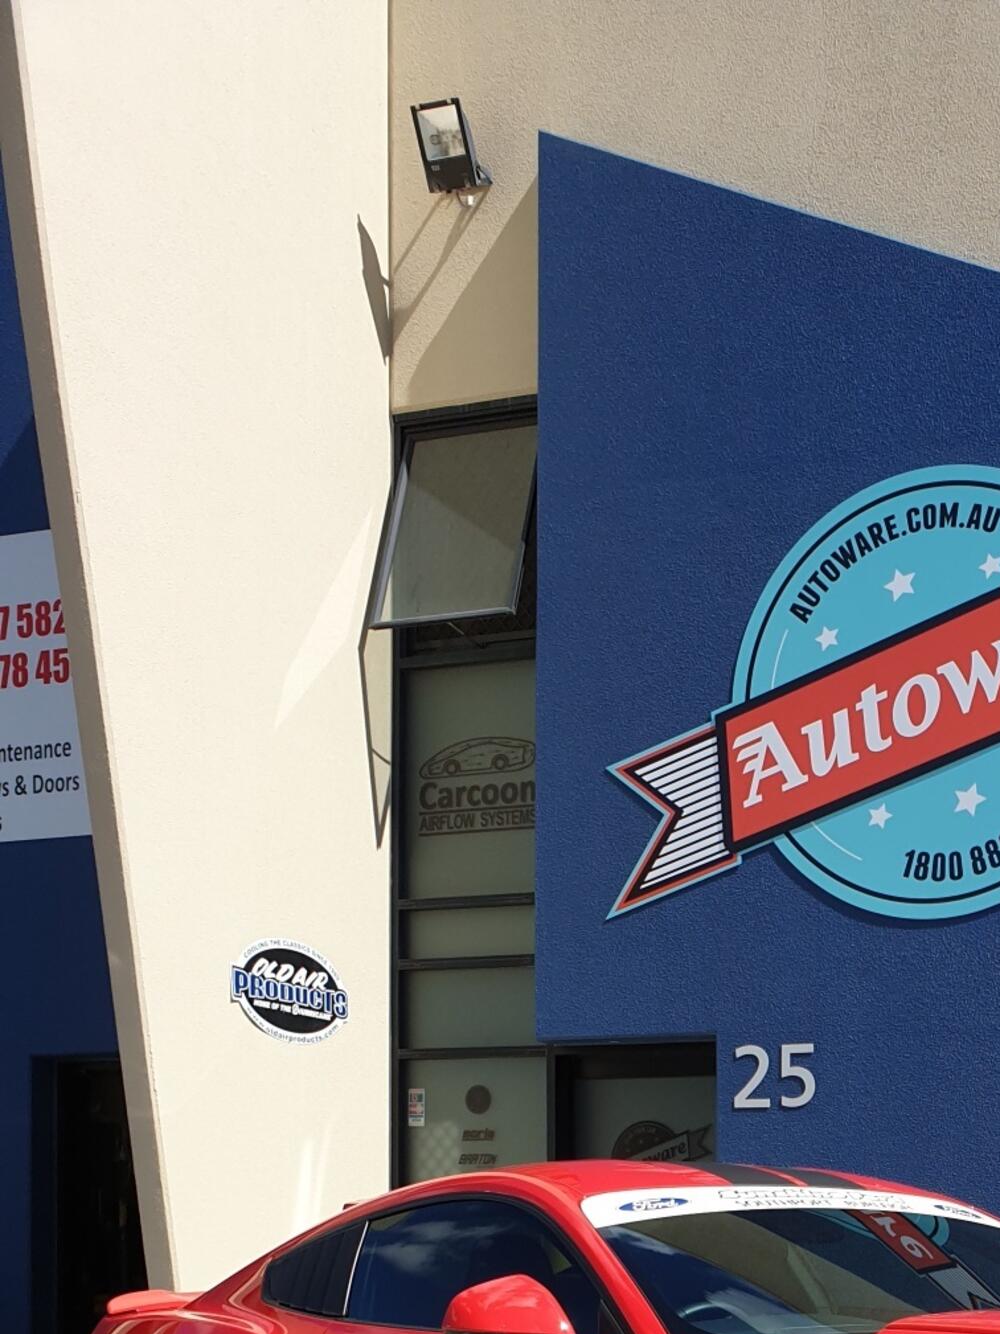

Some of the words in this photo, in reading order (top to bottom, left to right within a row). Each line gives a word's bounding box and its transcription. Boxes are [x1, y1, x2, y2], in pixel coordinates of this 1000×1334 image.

[15, 775, 27, 795] &
[33, 775, 80, 793] Doors
[419, 780, 536, 809] Carcoon
[419, 812, 476, 832] AIRFLOW
[903, 849, 963, 882] 1800
[252, 957, 294, 982] OLD
[292, 967, 329, 990] AIR
[231, 965, 348, 1019] PRODUCTS
[734, 1043, 816, 1109] 25
